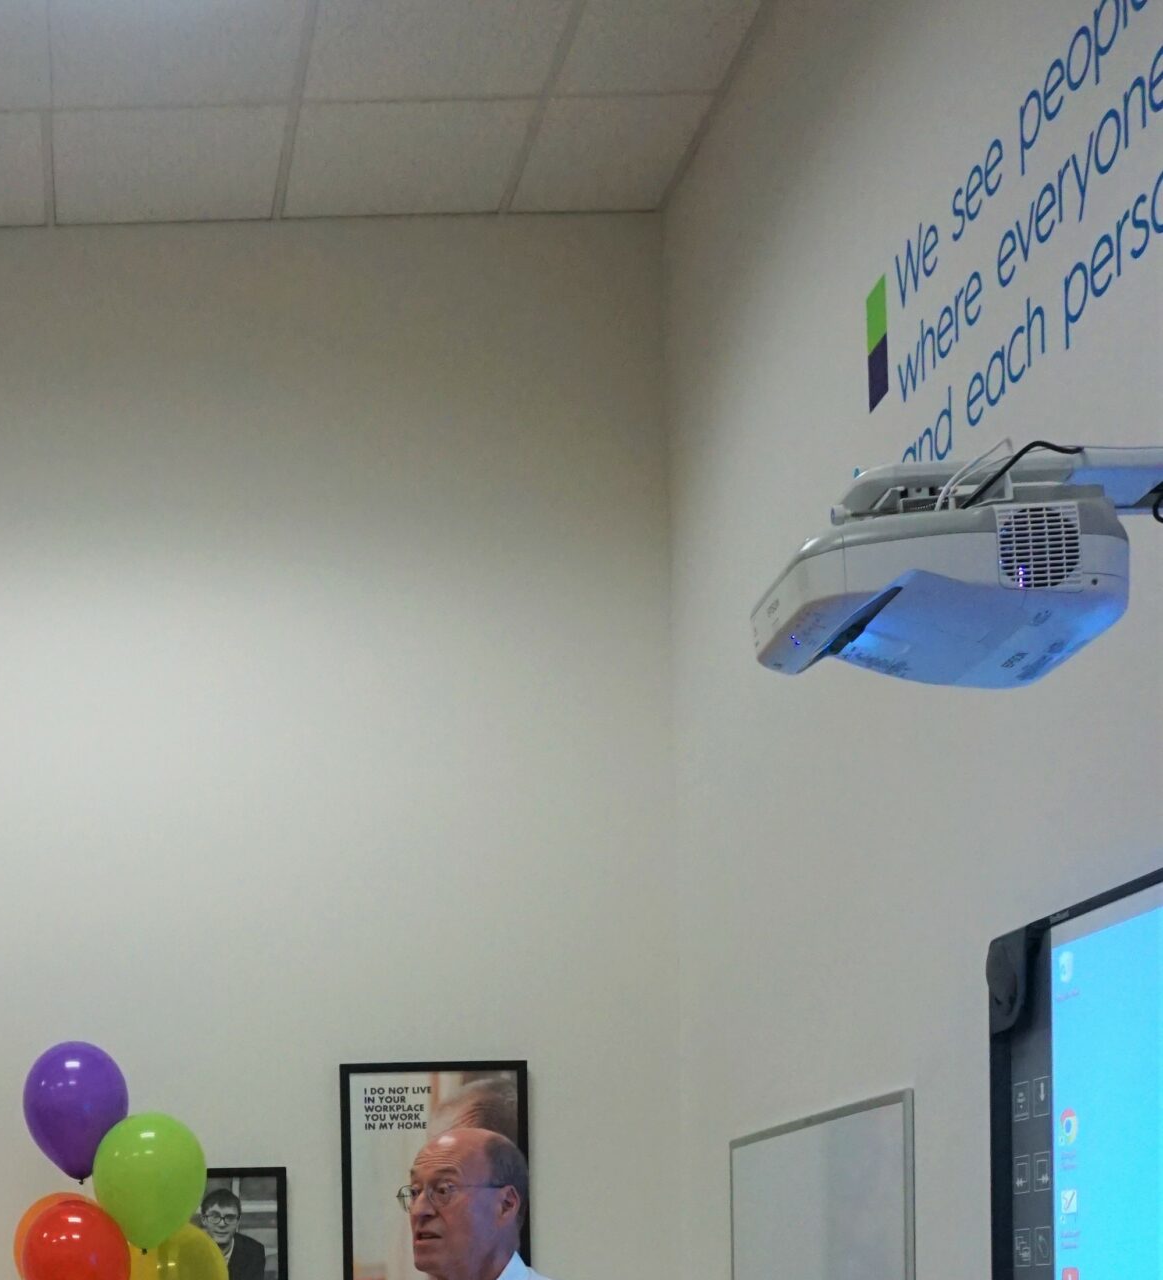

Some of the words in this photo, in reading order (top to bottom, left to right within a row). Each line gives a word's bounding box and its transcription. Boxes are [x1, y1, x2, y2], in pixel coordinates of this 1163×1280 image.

[895, 222, 938, 309] We
[952, 138, 1003, 241] see
[898, 271, 982, 402] where
[966, 297, 1046, 427] each
[370, 1087, 385, 1095] DO
[388, 1086, 409, 1094] NOT
[412, 1086, 432, 1094] LIVE
[364, 1096, 375, 1104] IN
[379, 1096, 406, 1104] YOUR
[364, 1104, 424, 1113] WORKPLACE
[365, 1113, 386, 1121] YOU
[389, 1113, 420, 1121] WORK
[365, 1122, 375, 1130] IN
[379, 1122, 394, 1130] MY
[397, 1121, 427, 1130] HOME
